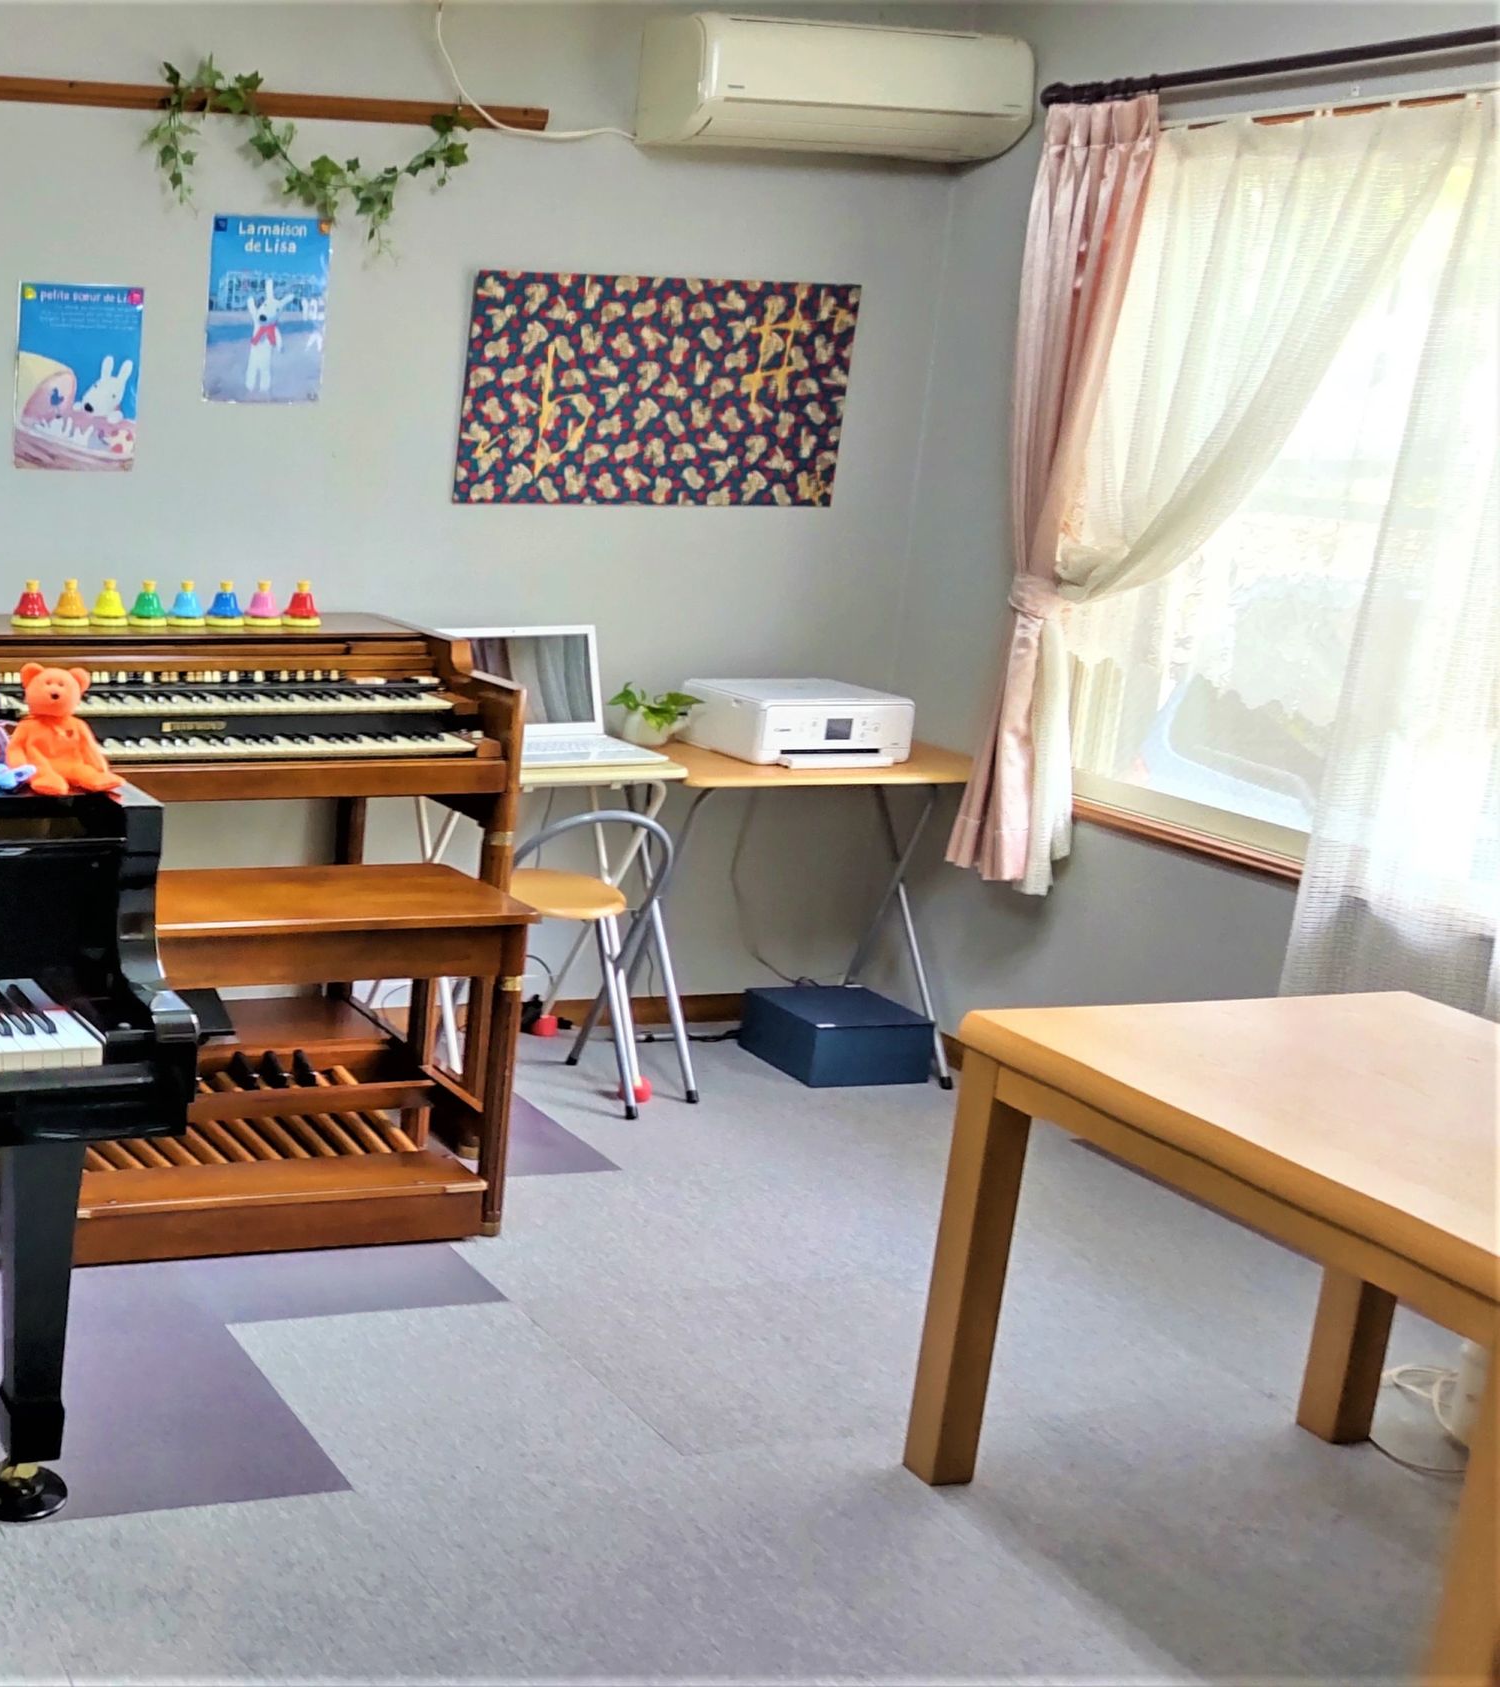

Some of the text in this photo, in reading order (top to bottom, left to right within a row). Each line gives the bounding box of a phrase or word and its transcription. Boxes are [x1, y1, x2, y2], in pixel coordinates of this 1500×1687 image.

[238, 220, 308, 237] La maison
[244, 238, 297, 255] de Lisa
